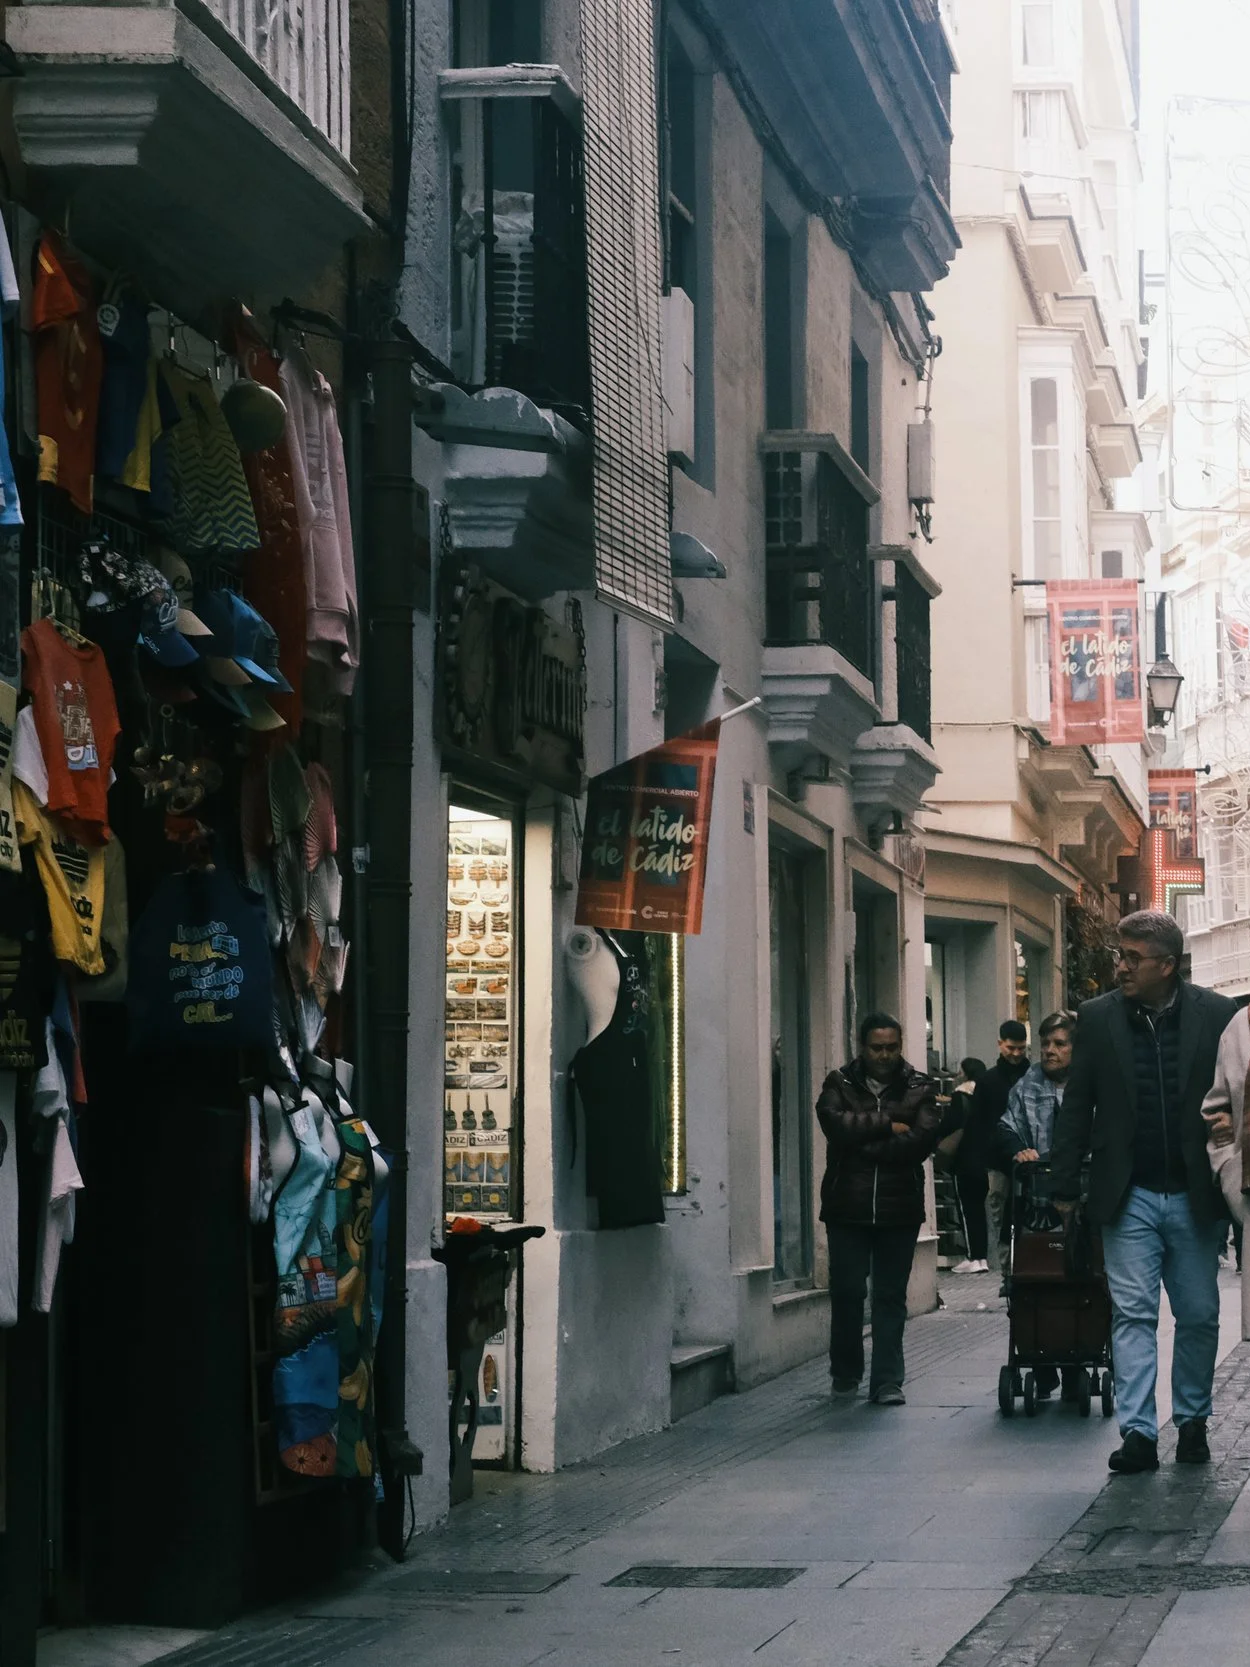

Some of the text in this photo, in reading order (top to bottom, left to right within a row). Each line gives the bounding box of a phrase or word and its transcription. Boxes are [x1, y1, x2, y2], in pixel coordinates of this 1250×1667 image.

[1082, 630, 1132, 656] latido
[1059, 656, 1132, 678] de Cádiz
[670, 789, 700, 798] ABIERTO
[630, 805, 700, 845] latido
[1156, 807, 1192, 827] latido
[591, 841, 697, 877] de Cádiz
[191, 965, 244, 989] MUNDO
